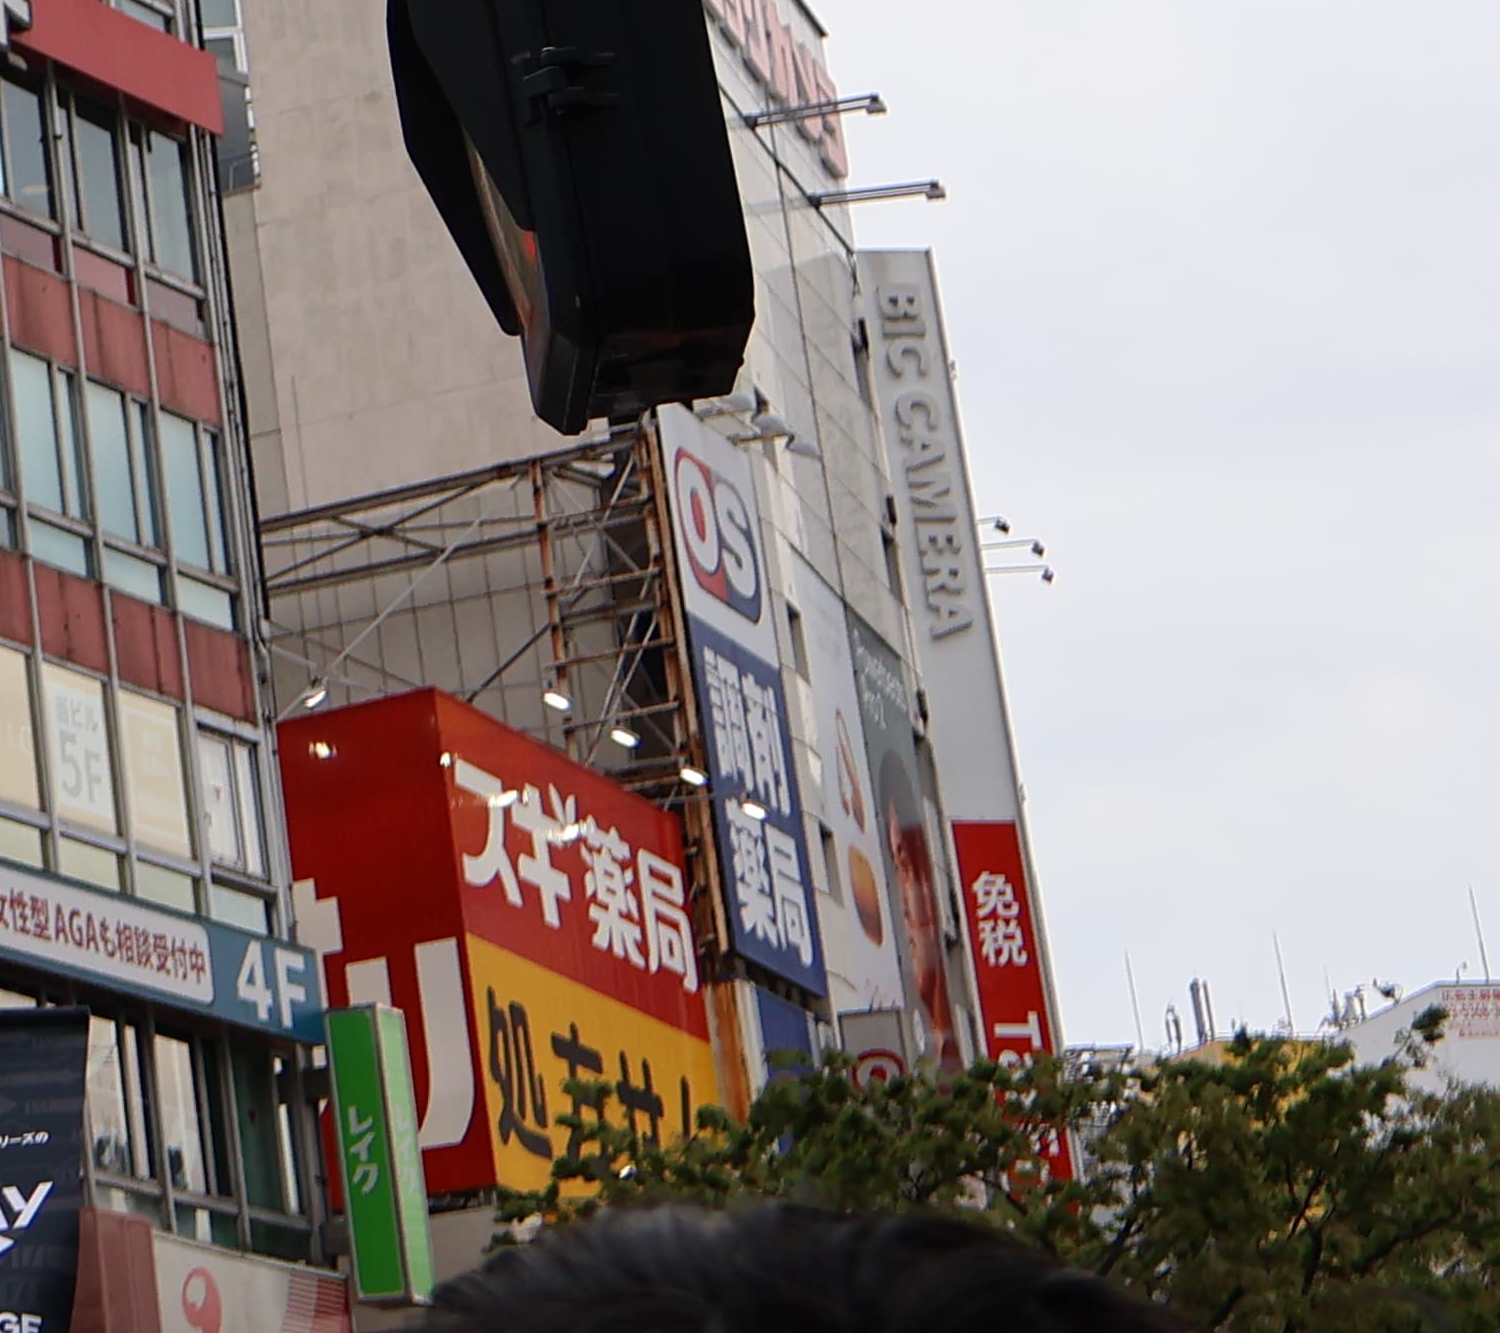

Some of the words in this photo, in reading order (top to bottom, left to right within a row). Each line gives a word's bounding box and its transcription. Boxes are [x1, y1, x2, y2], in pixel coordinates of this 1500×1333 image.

[878, 285, 928, 379] BIC
[677, 448, 761, 608] OS
[895, 392, 974, 643] CAMERA
[58, 730, 103, 804] 5F
[703, 645, 792, 818] 調剤
[454, 757, 700, 994] スギ薬局
[727, 798, 812, 968] 薬局
[971, 870, 1028, 967] 免税
[237, 941, 306, 1028] 4F
[348, 1105, 380, 1195] レイク
